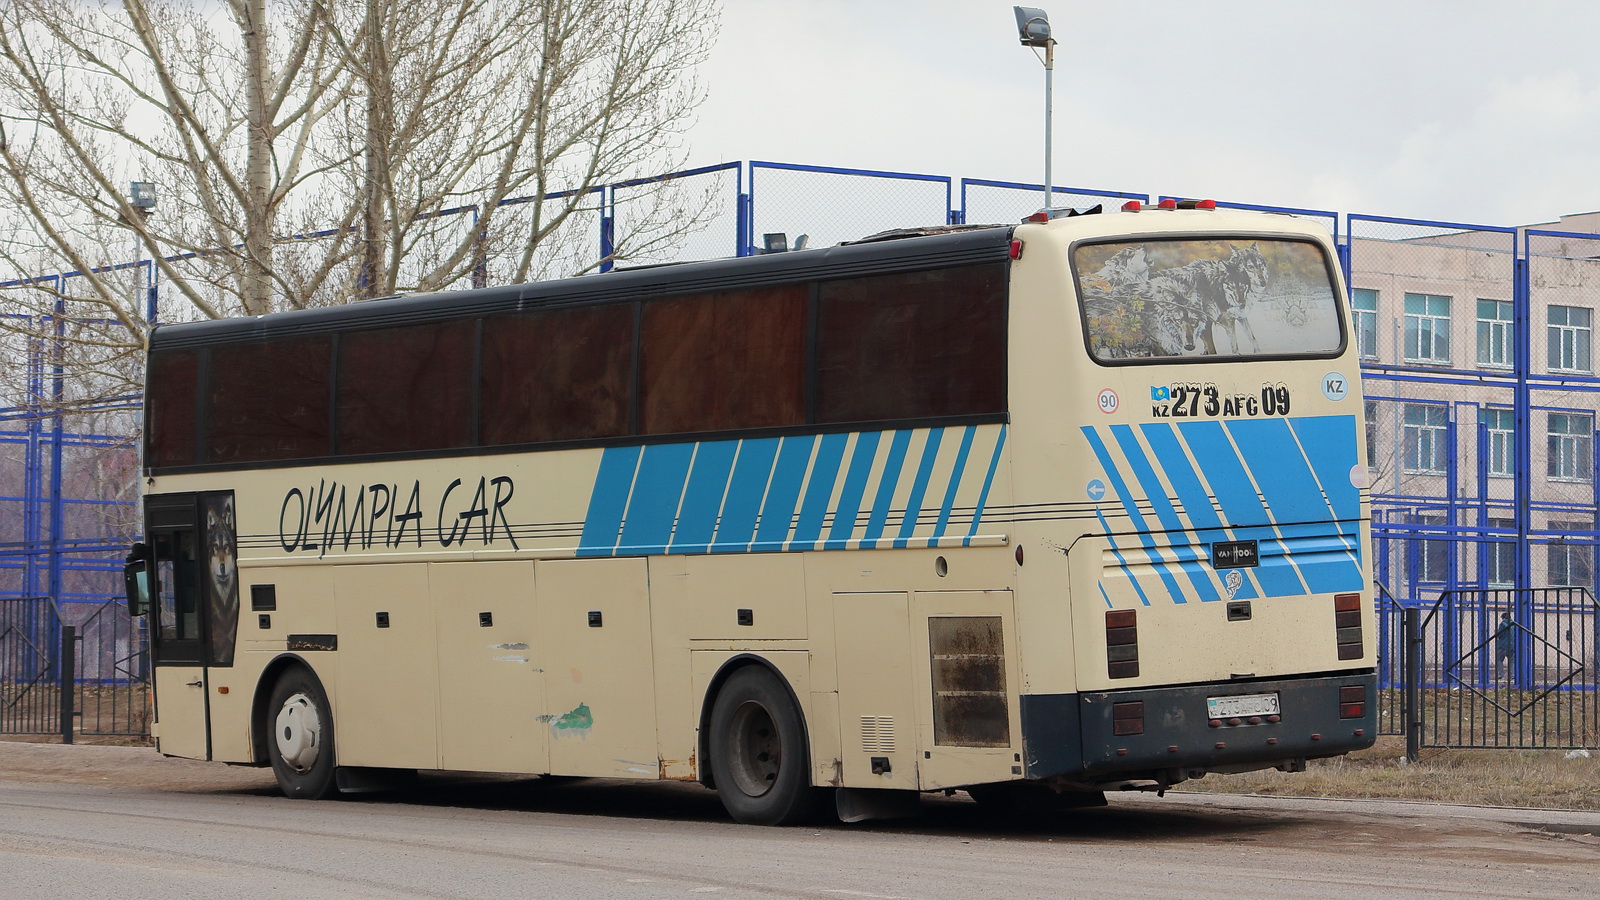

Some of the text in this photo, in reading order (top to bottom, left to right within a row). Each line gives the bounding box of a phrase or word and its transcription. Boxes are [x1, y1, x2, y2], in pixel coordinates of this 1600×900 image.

[1326, 380, 1344, 393] KZ
[1101, 395, 1115, 407] 90
[1152, 381, 1290, 417] KZ 273 AFC 09
[279, 475, 520, 560] OLYMPIA CAR
